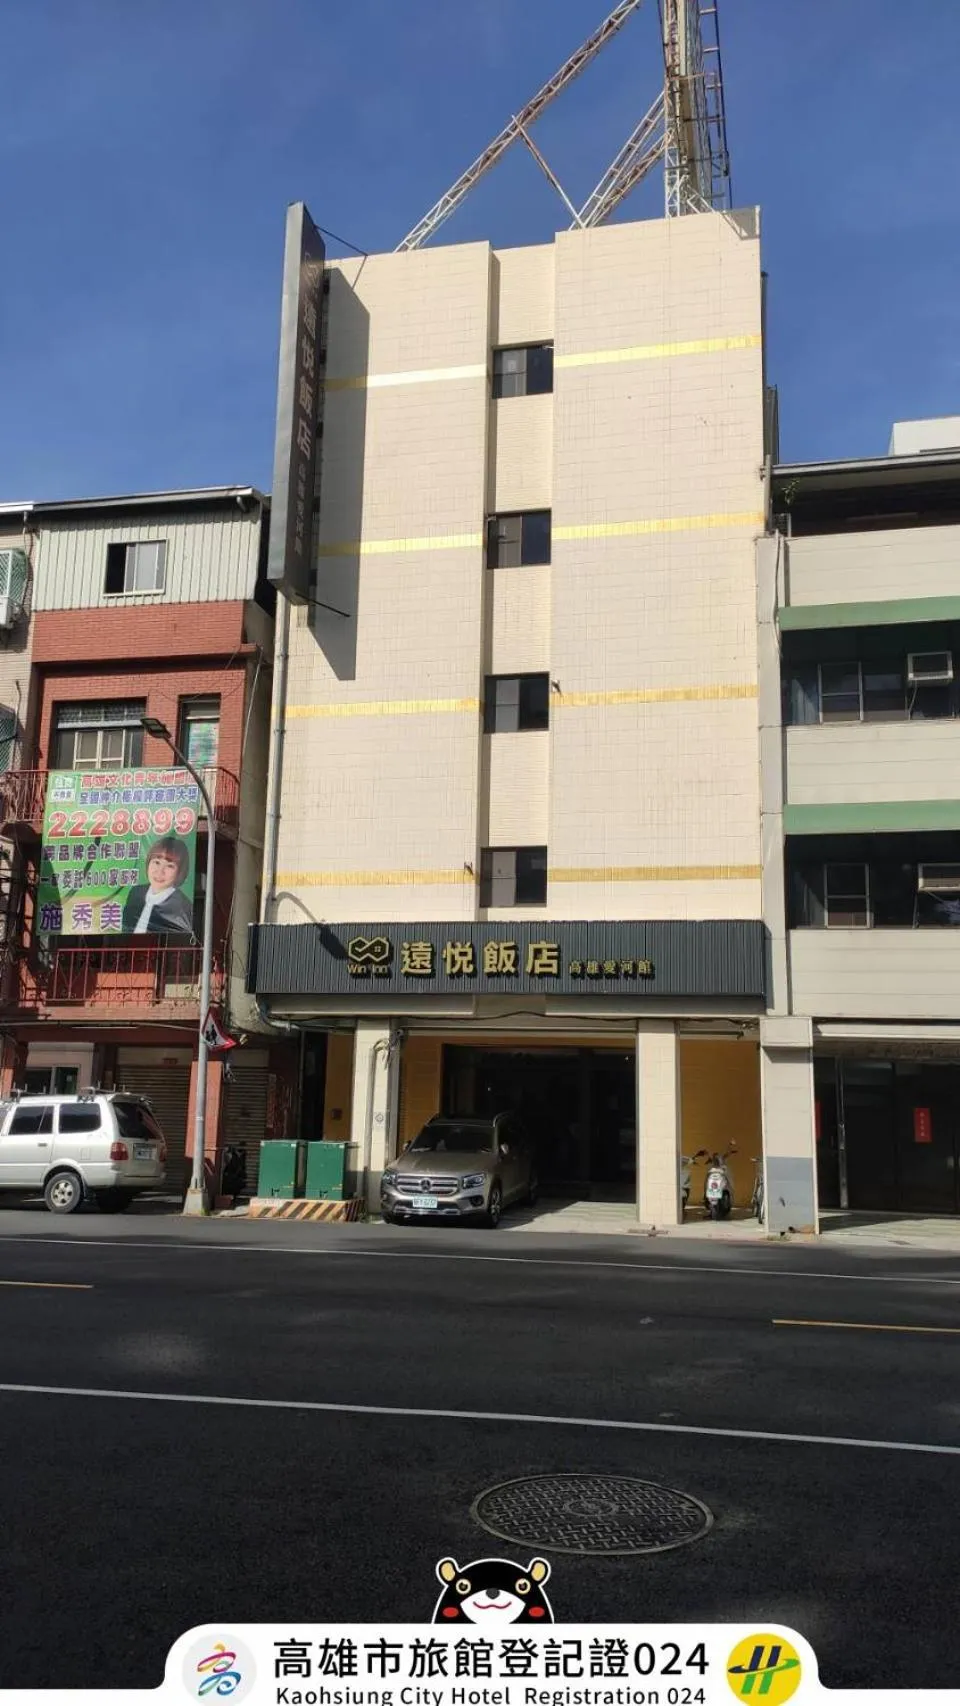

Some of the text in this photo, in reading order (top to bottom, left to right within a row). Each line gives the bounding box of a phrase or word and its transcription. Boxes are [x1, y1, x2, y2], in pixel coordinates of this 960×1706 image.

[47, 808, 196, 838] 2228899
[40, 904, 122, 931] 施秀美
[347, 963, 367, 973] Win
[400, 940, 652, 975] 遠悅飯店 高雄愛河館
